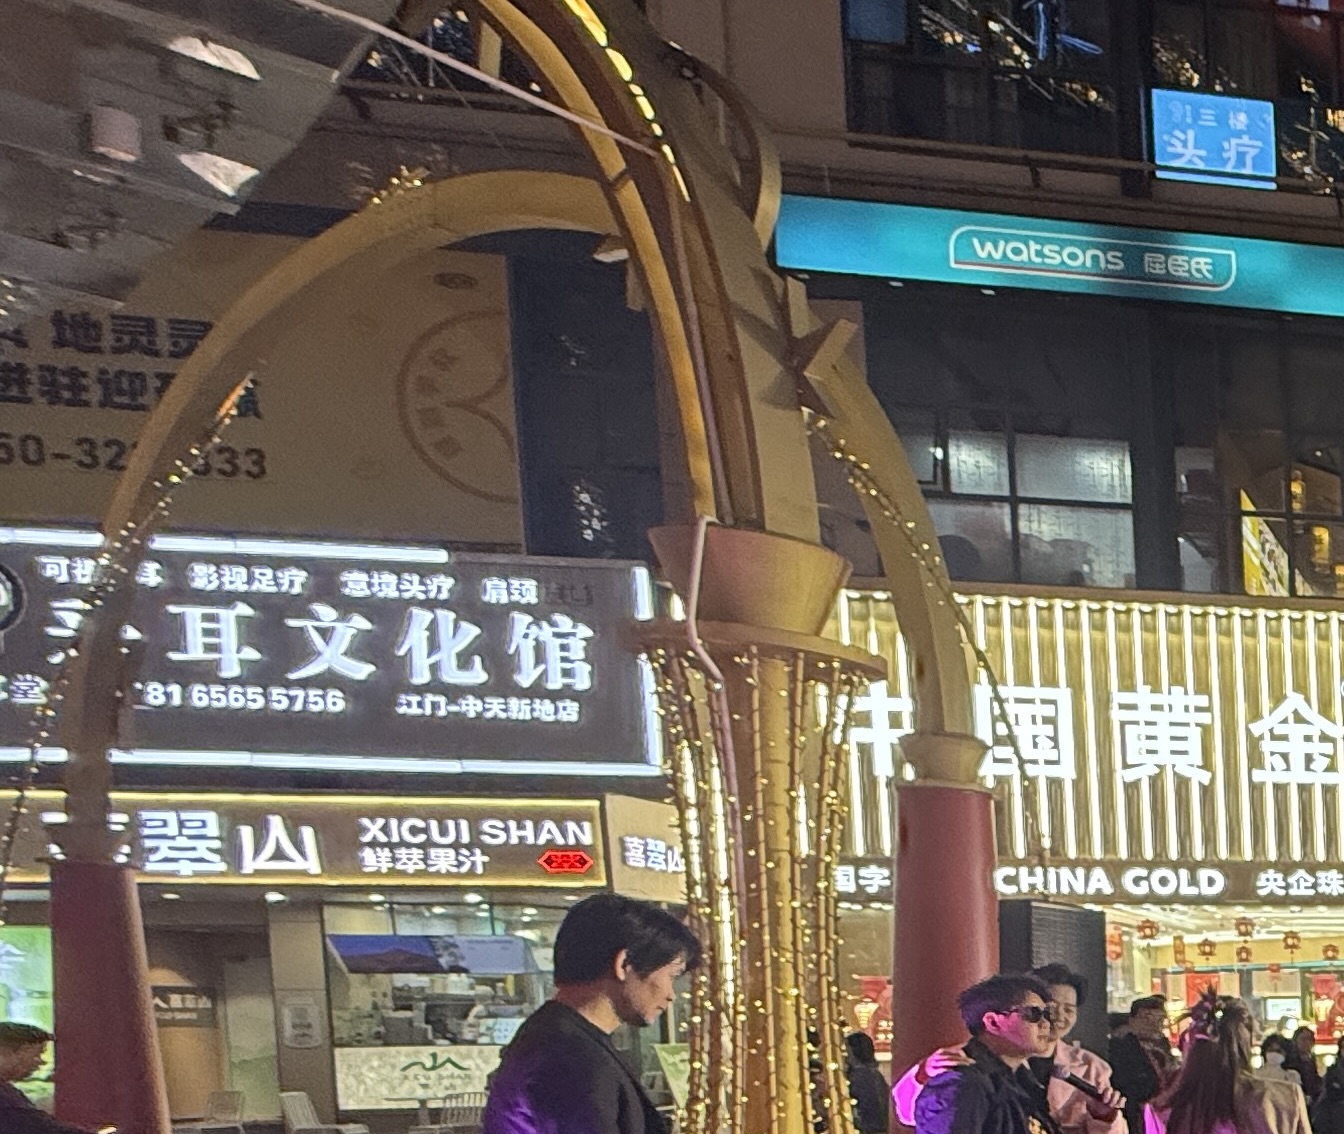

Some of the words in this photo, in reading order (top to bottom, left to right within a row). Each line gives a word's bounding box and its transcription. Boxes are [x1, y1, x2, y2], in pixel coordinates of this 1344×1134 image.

[1163, 129, 1265, 174] 头疗
[971, 237, 1126, 271] watsons
[1143, 252, 1214, 280] 屈臣氏
[187, 561, 308, 595] 影视足疗
[339, 569, 456, 601] 意境头疗
[481, 576, 539, 605] 肩颈
[189, 683, 266, 711] 6565
[268, 686, 347, 714] 5756
[395, 693, 581, 724] 江门-中天新地店
[358, 817, 472, 845] XICUI
[478, 819, 594, 847] SHAN
[358, 847, 491, 875] 鲜萃果汁
[992, 866, 1114, 896] CHINA
[1121, 867, 1227, 897] GOLD
